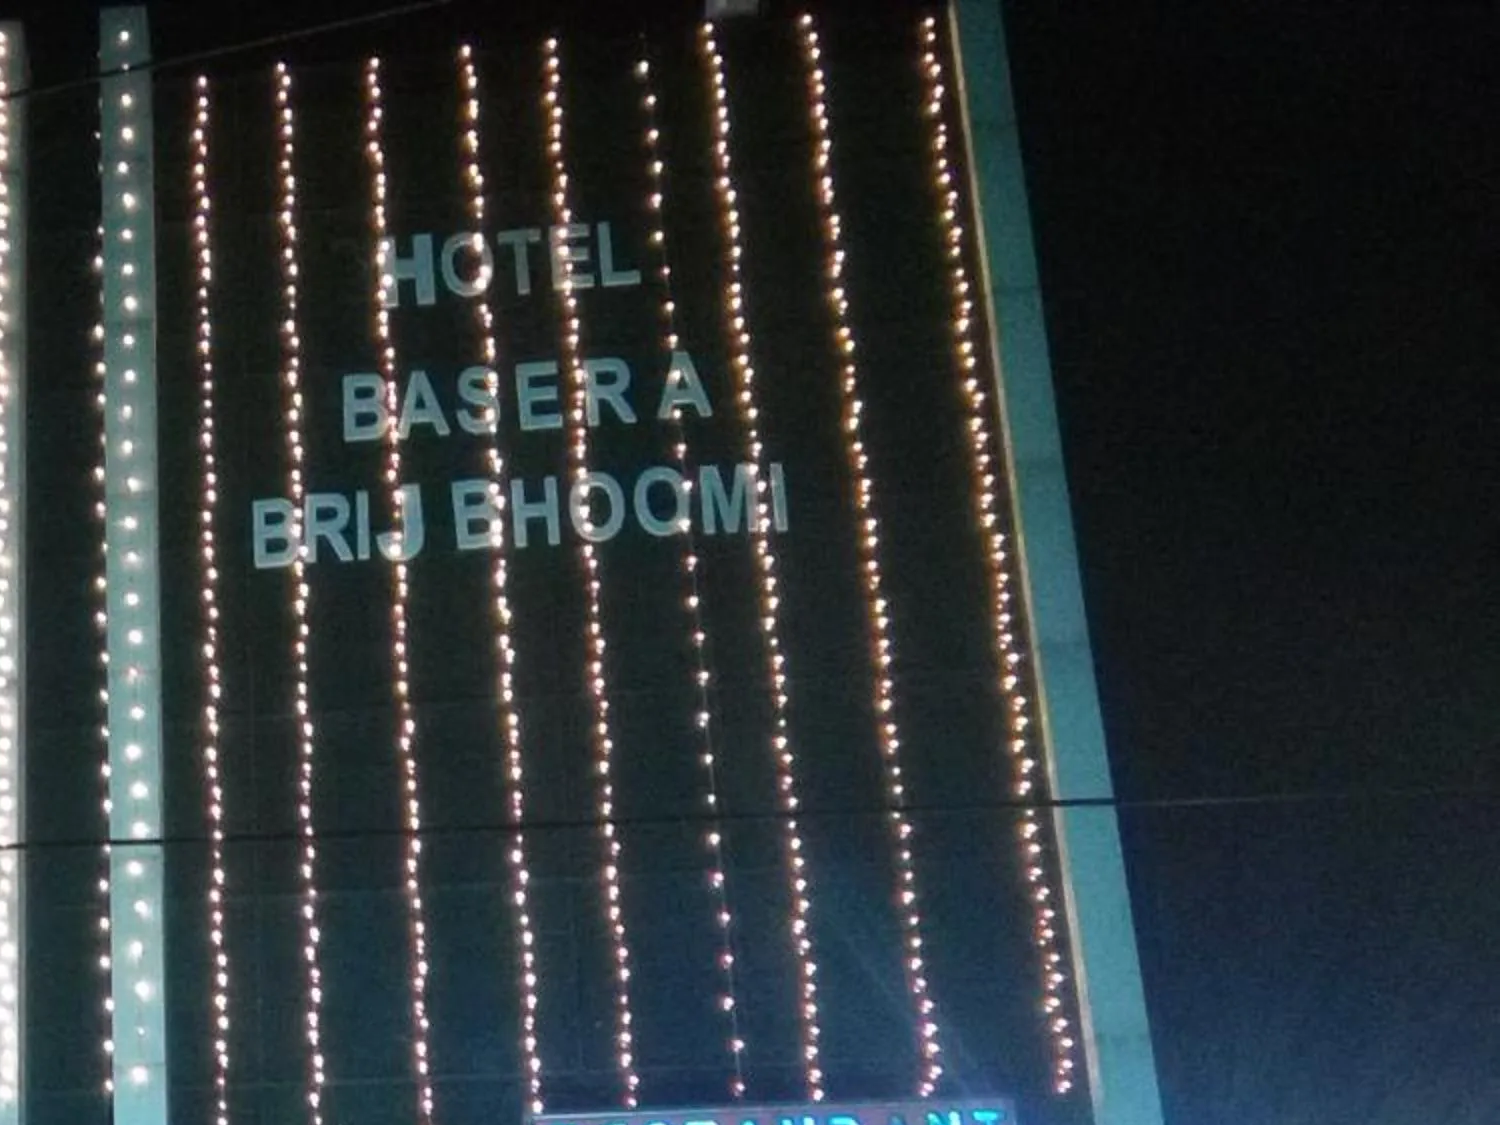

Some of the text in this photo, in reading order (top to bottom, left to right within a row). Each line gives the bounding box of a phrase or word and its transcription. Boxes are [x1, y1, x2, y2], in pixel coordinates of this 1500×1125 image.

[380, 222, 641, 309] HOTEL
[340, 350, 713, 443] BASERA
[251, 462, 789, 570] BRIJ BHOOMI
